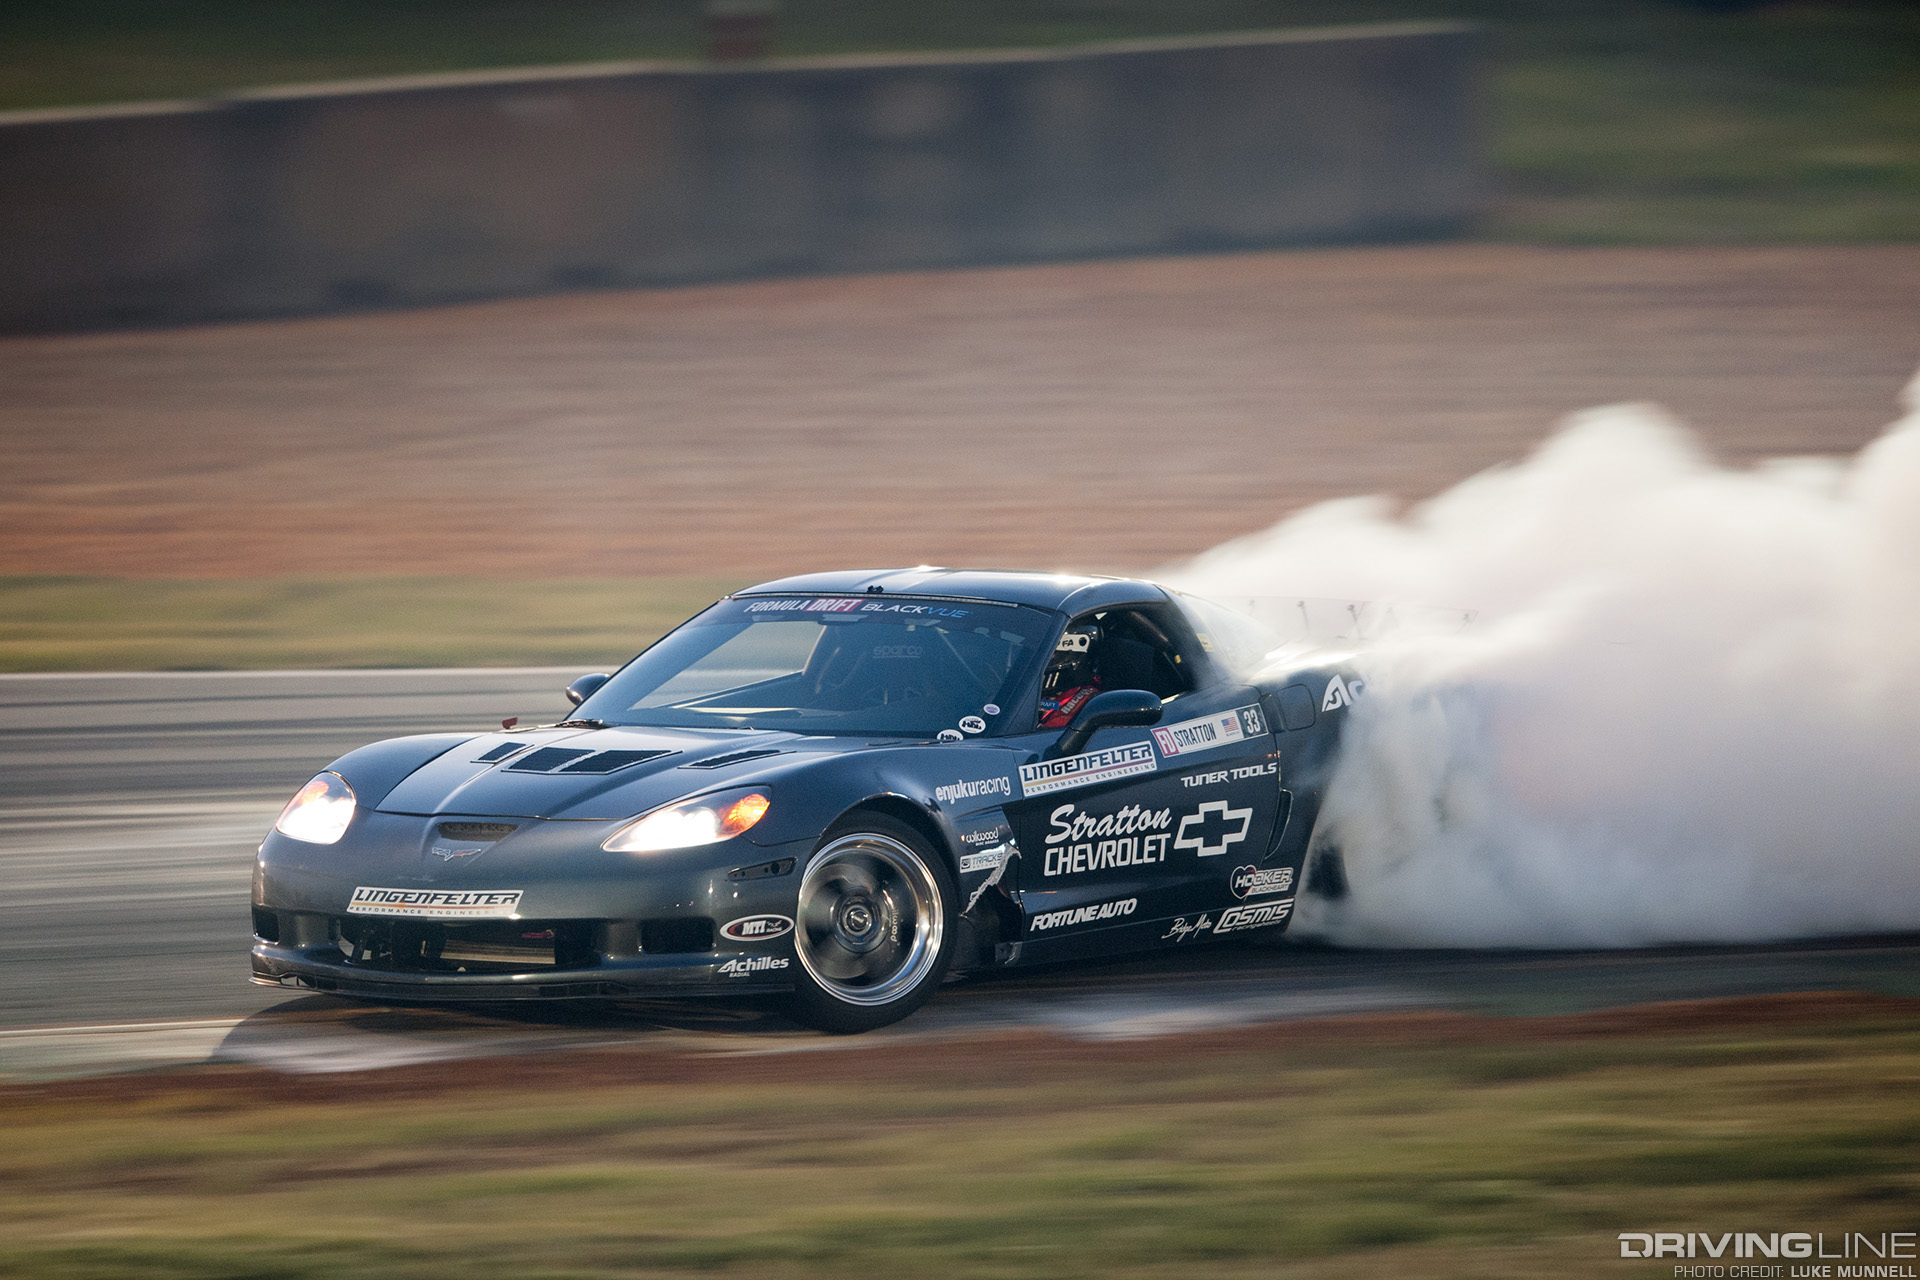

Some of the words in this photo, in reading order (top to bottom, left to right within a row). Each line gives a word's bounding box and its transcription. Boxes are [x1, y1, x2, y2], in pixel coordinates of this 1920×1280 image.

[744, 600, 811, 613] FORMULA
[809, 598, 861, 612] DRIFT
[1173, 722, 1217, 748] STRATTON
[1243, 709, 1261, 734] 33
[1021, 745, 1153, 783] LINGENFELTER
[1180, 770, 1230, 788] TUNER
[1229, 762, 1278, 780] TOOLS
[935, 776, 1011, 804] enjukuracing
[1024, 776, 1091, 795] PERFORMANCE
[1096, 763, 1156, 781] ENGINEERING
[1044, 803, 1173, 844] Stratton
[1043, 832, 1172, 877] CHEVROLET
[1234, 869, 1293, 889] HOOKER
[354, 889, 521, 905] LINGENFELTER
[741, 920, 767, 936] MTI
[717, 956, 790, 973] Achilles
